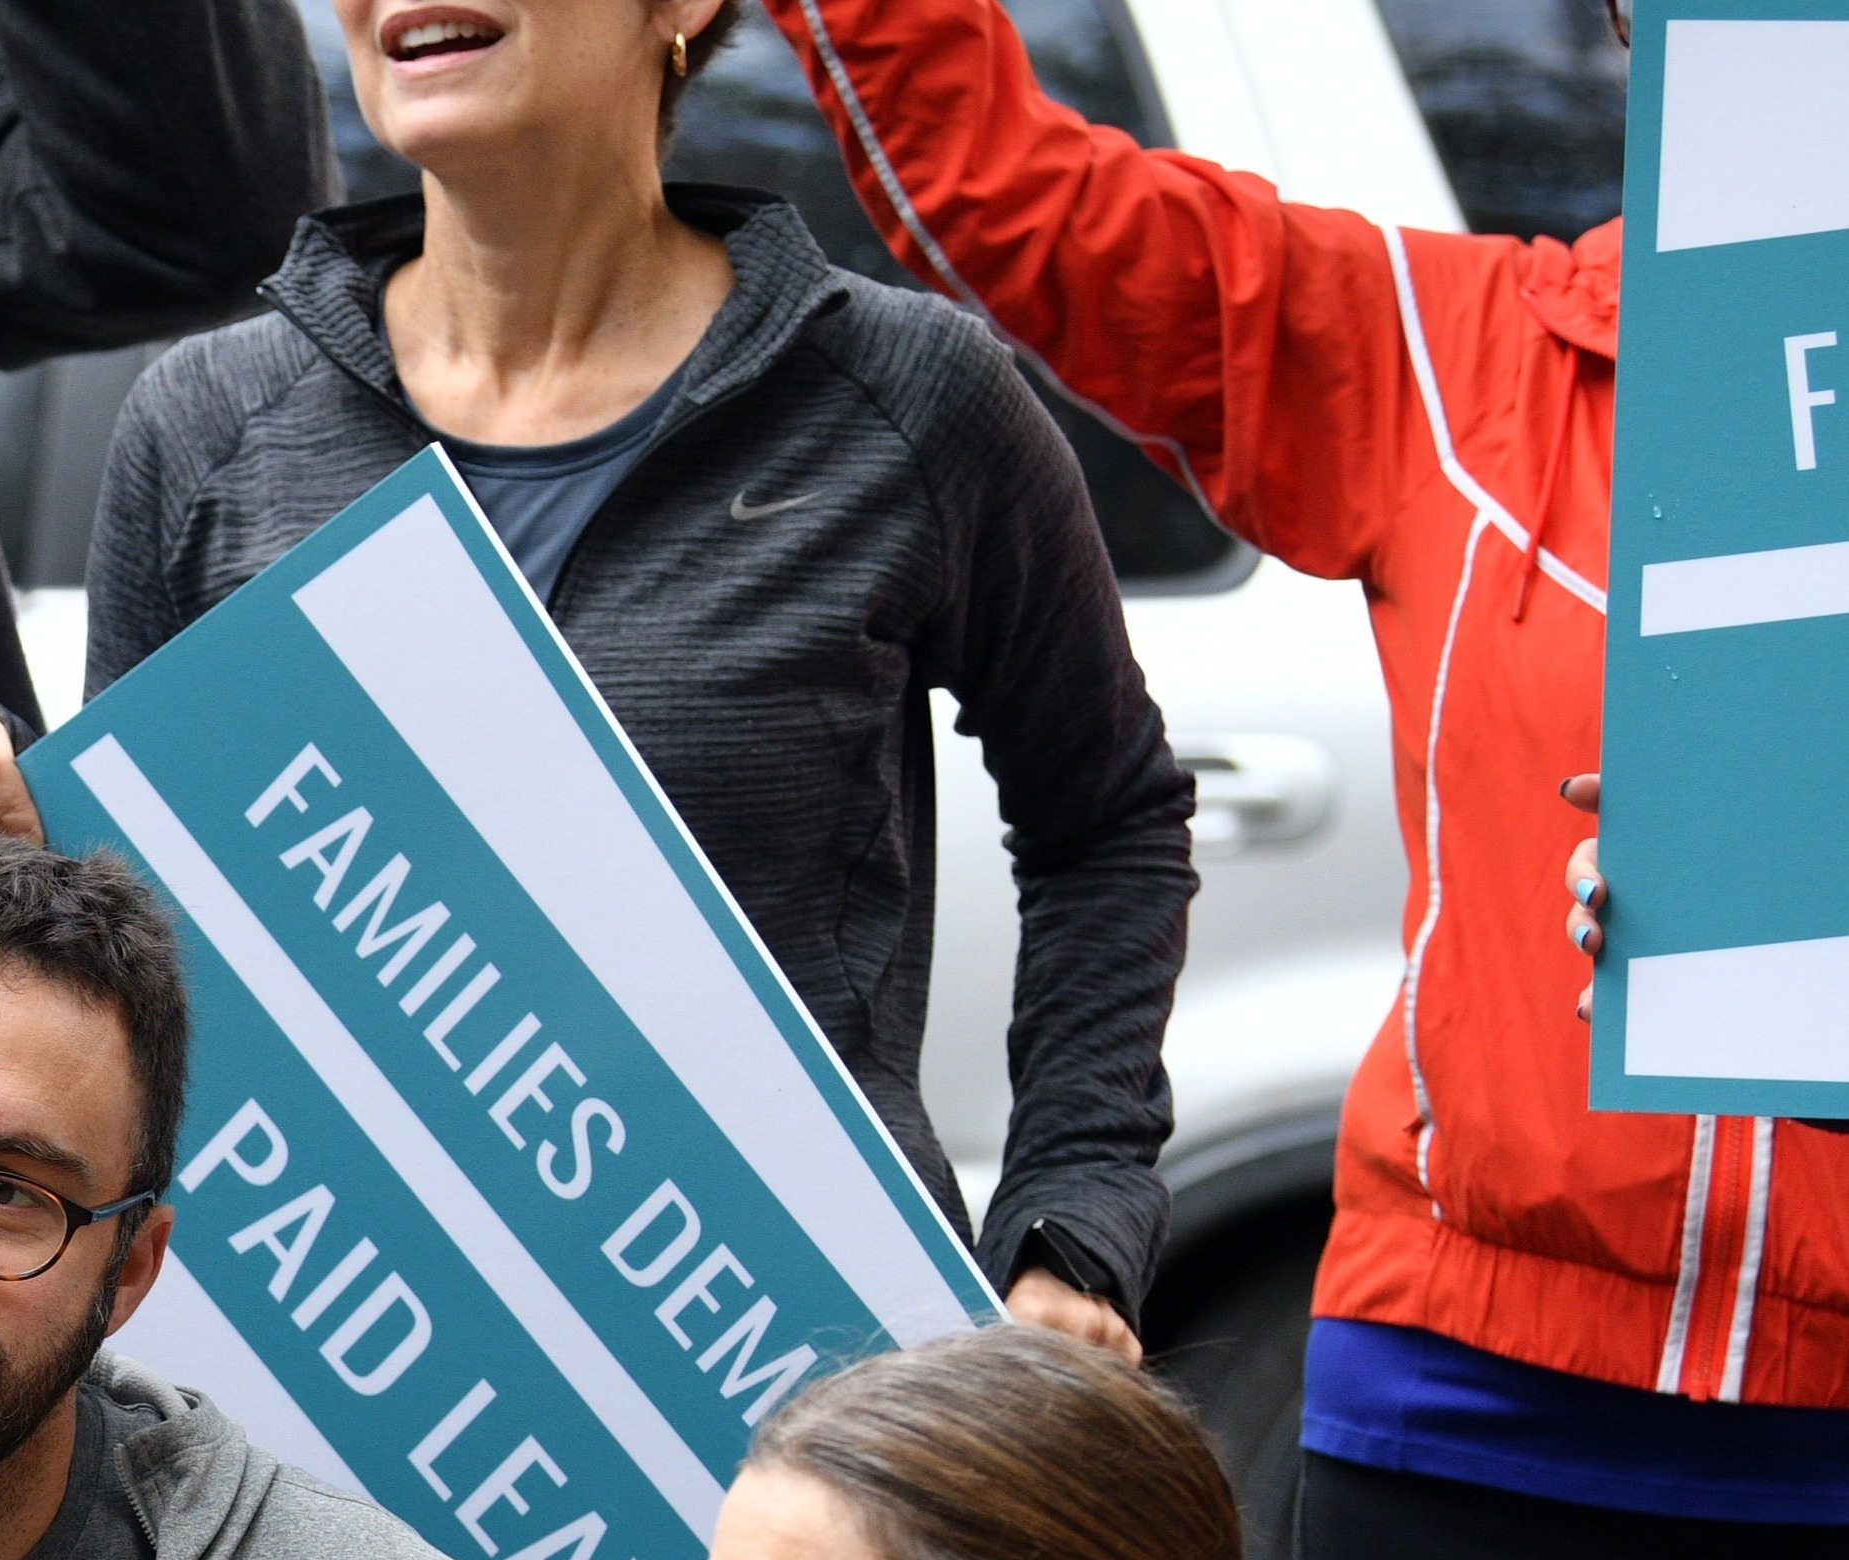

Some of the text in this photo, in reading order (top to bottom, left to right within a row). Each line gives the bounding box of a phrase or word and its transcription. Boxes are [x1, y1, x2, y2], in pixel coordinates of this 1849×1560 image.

[1783, 331, 1837, 471] F
[244, 742, 819, 1427] FAMILIES DEM
[176, 1097, 434, 1399] PAID
